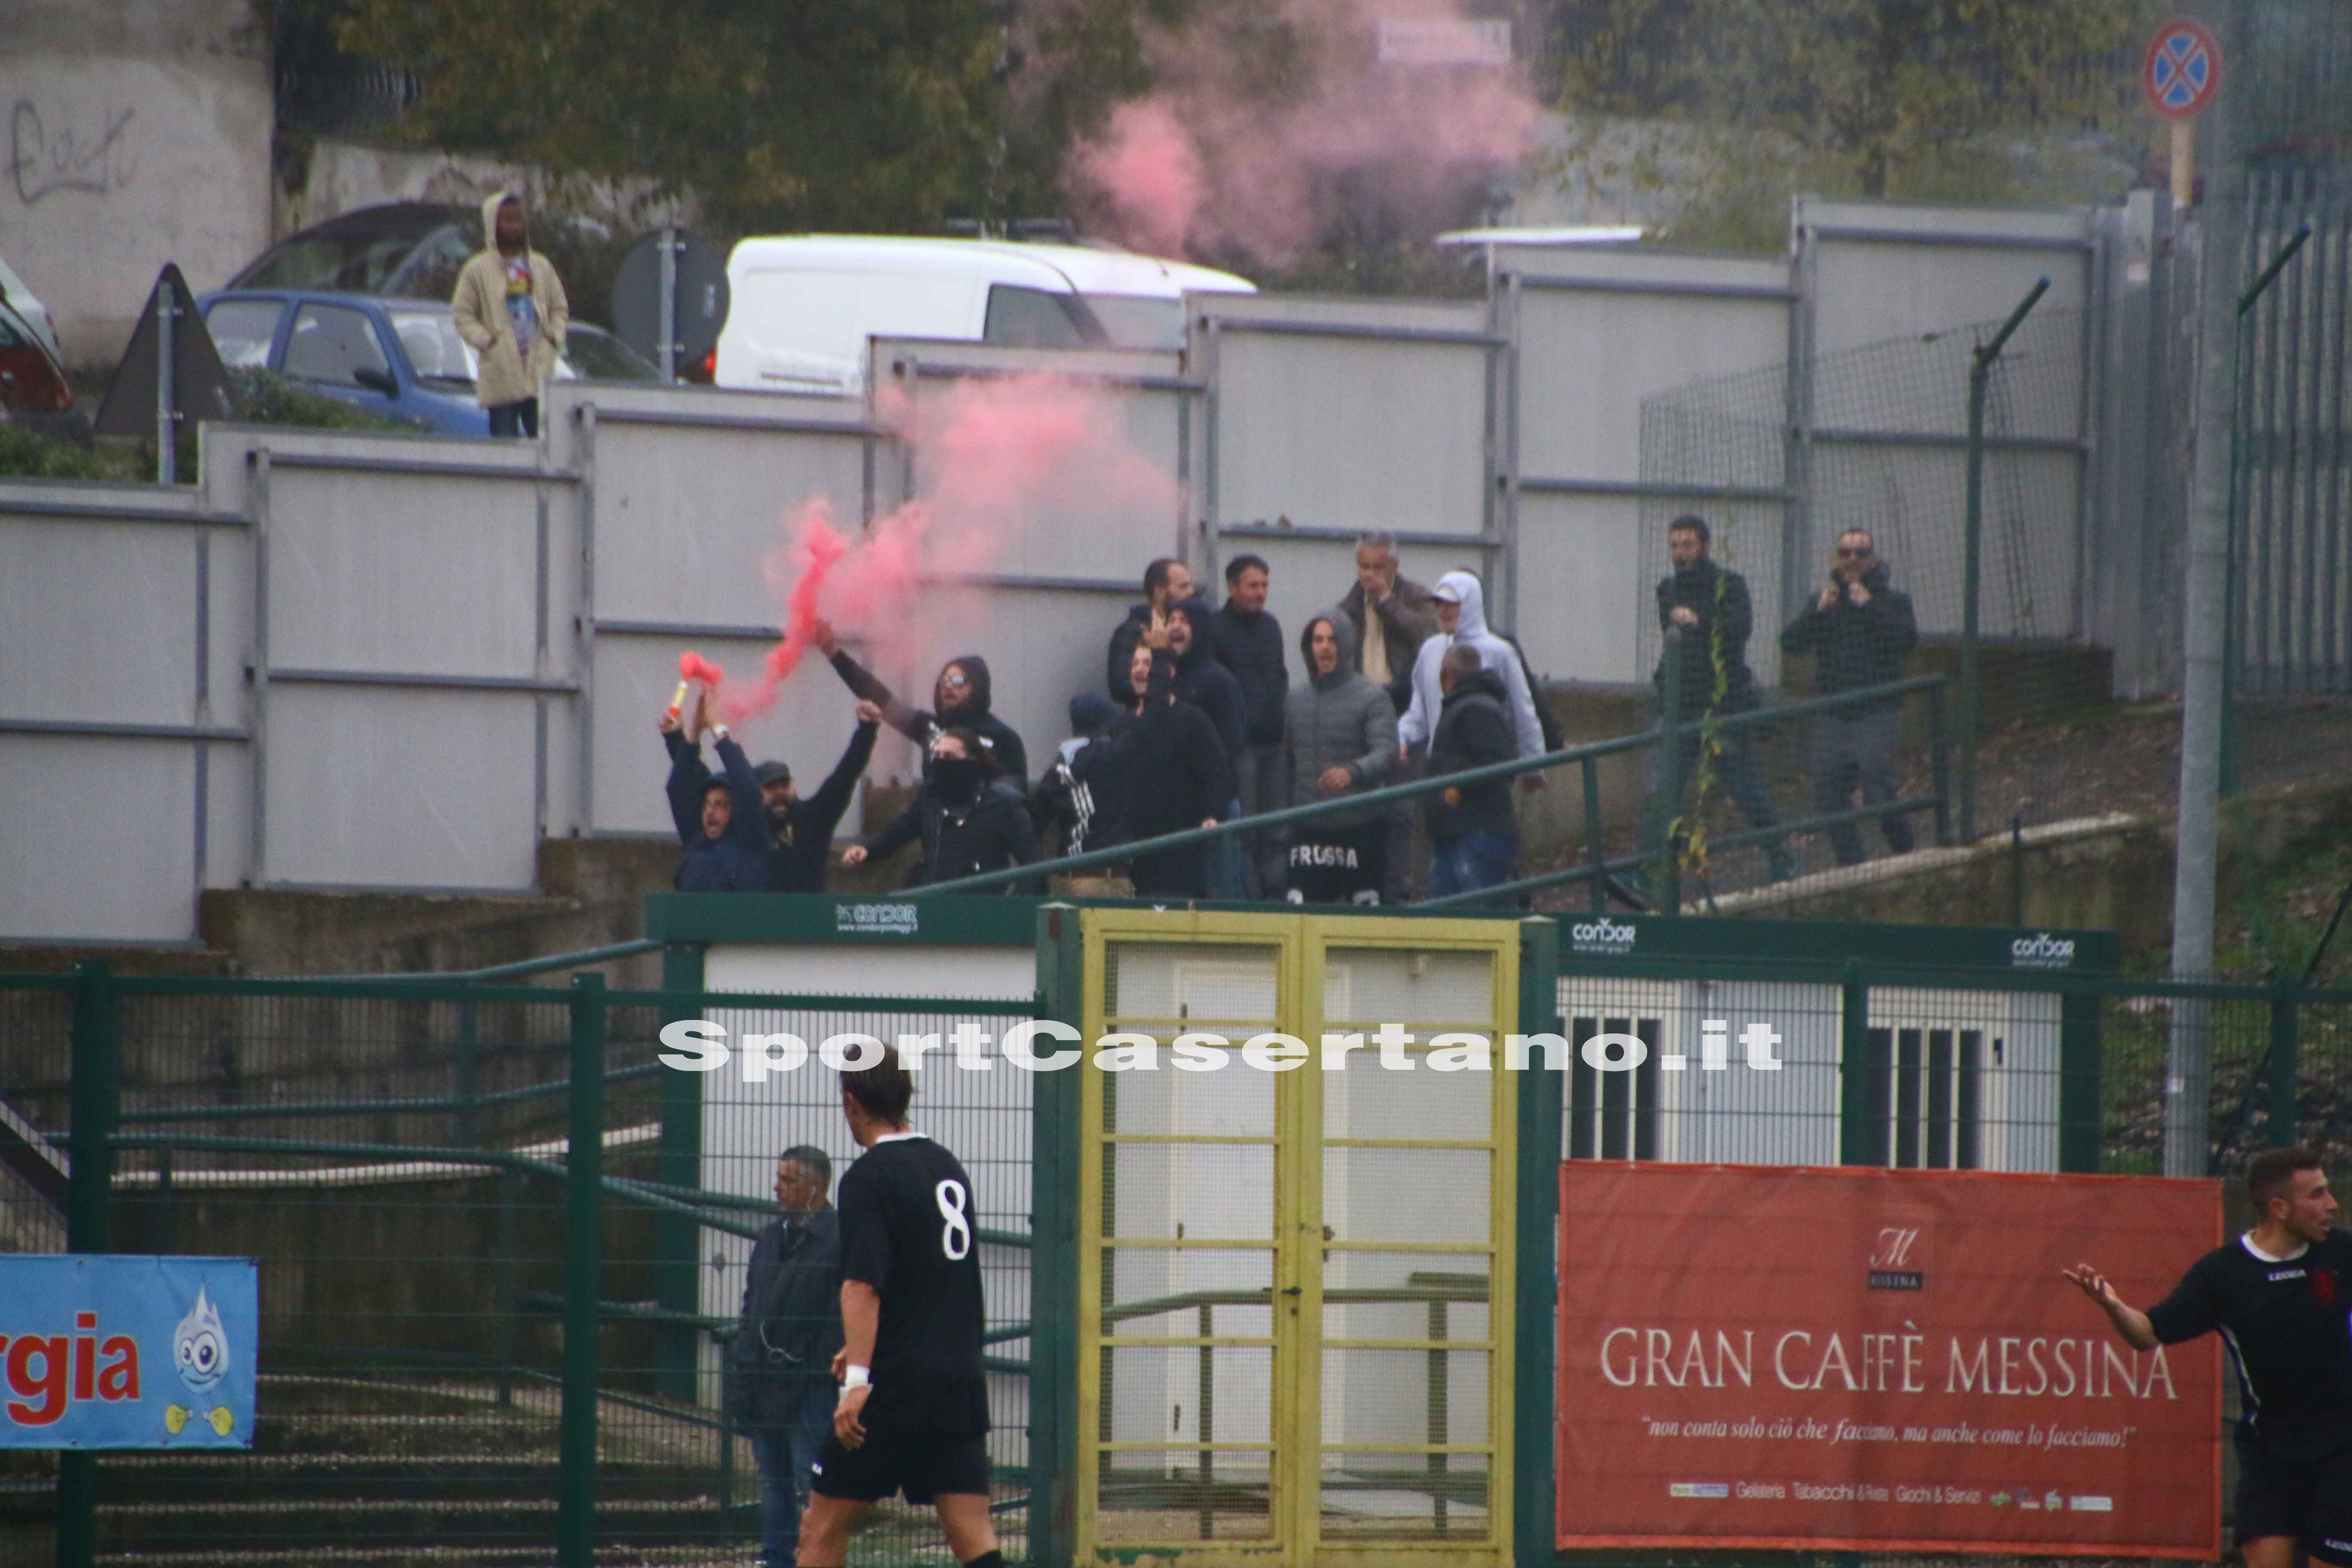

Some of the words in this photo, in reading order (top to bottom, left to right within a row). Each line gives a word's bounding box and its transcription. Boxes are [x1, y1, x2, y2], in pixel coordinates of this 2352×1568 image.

[936, 1179, 970, 1260] 8
[0, 1312, 140, 1426] gia
[1601, 1327, 1754, 1387] GRAN
[1774, 1320, 1924, 1393] CAFFÈ
[1945, 1336, 2178, 1399] MESSINA
[1683, 1420, 1727, 1437] conta
[1731, 1417, 1764, 1438] solo
[1796, 1418, 1828, 1439] che
[1903, 1426, 1926, 1441] ma
[1931, 1421, 1978, 1443] anche
[1982, 1430, 2022, 1445] come
[2027, 1423, 2043, 1445] lo
